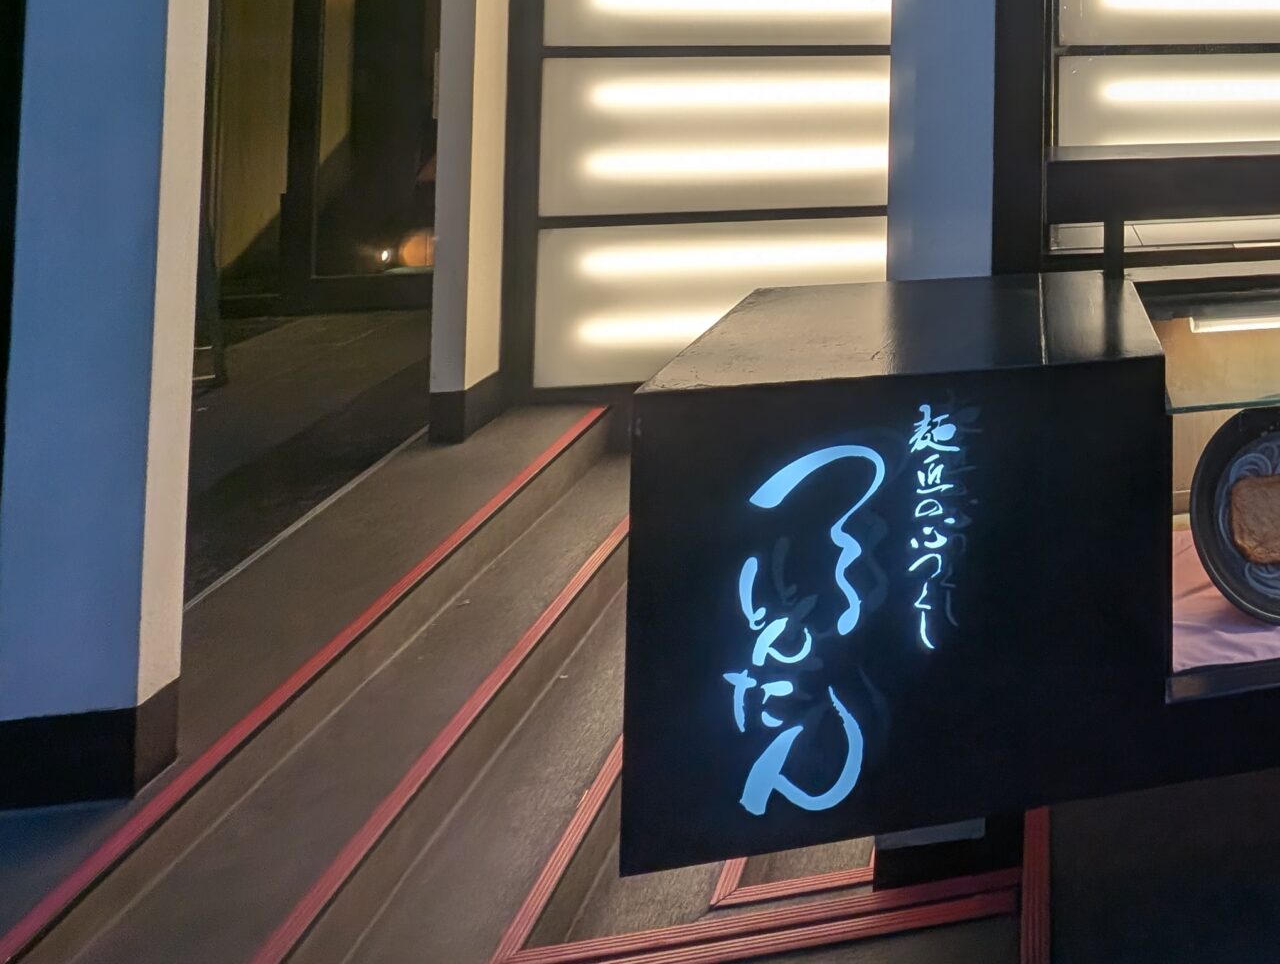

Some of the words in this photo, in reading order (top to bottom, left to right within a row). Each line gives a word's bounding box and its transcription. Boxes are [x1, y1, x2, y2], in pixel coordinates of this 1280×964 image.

[723, 443, 886, 815] つるとんたん
